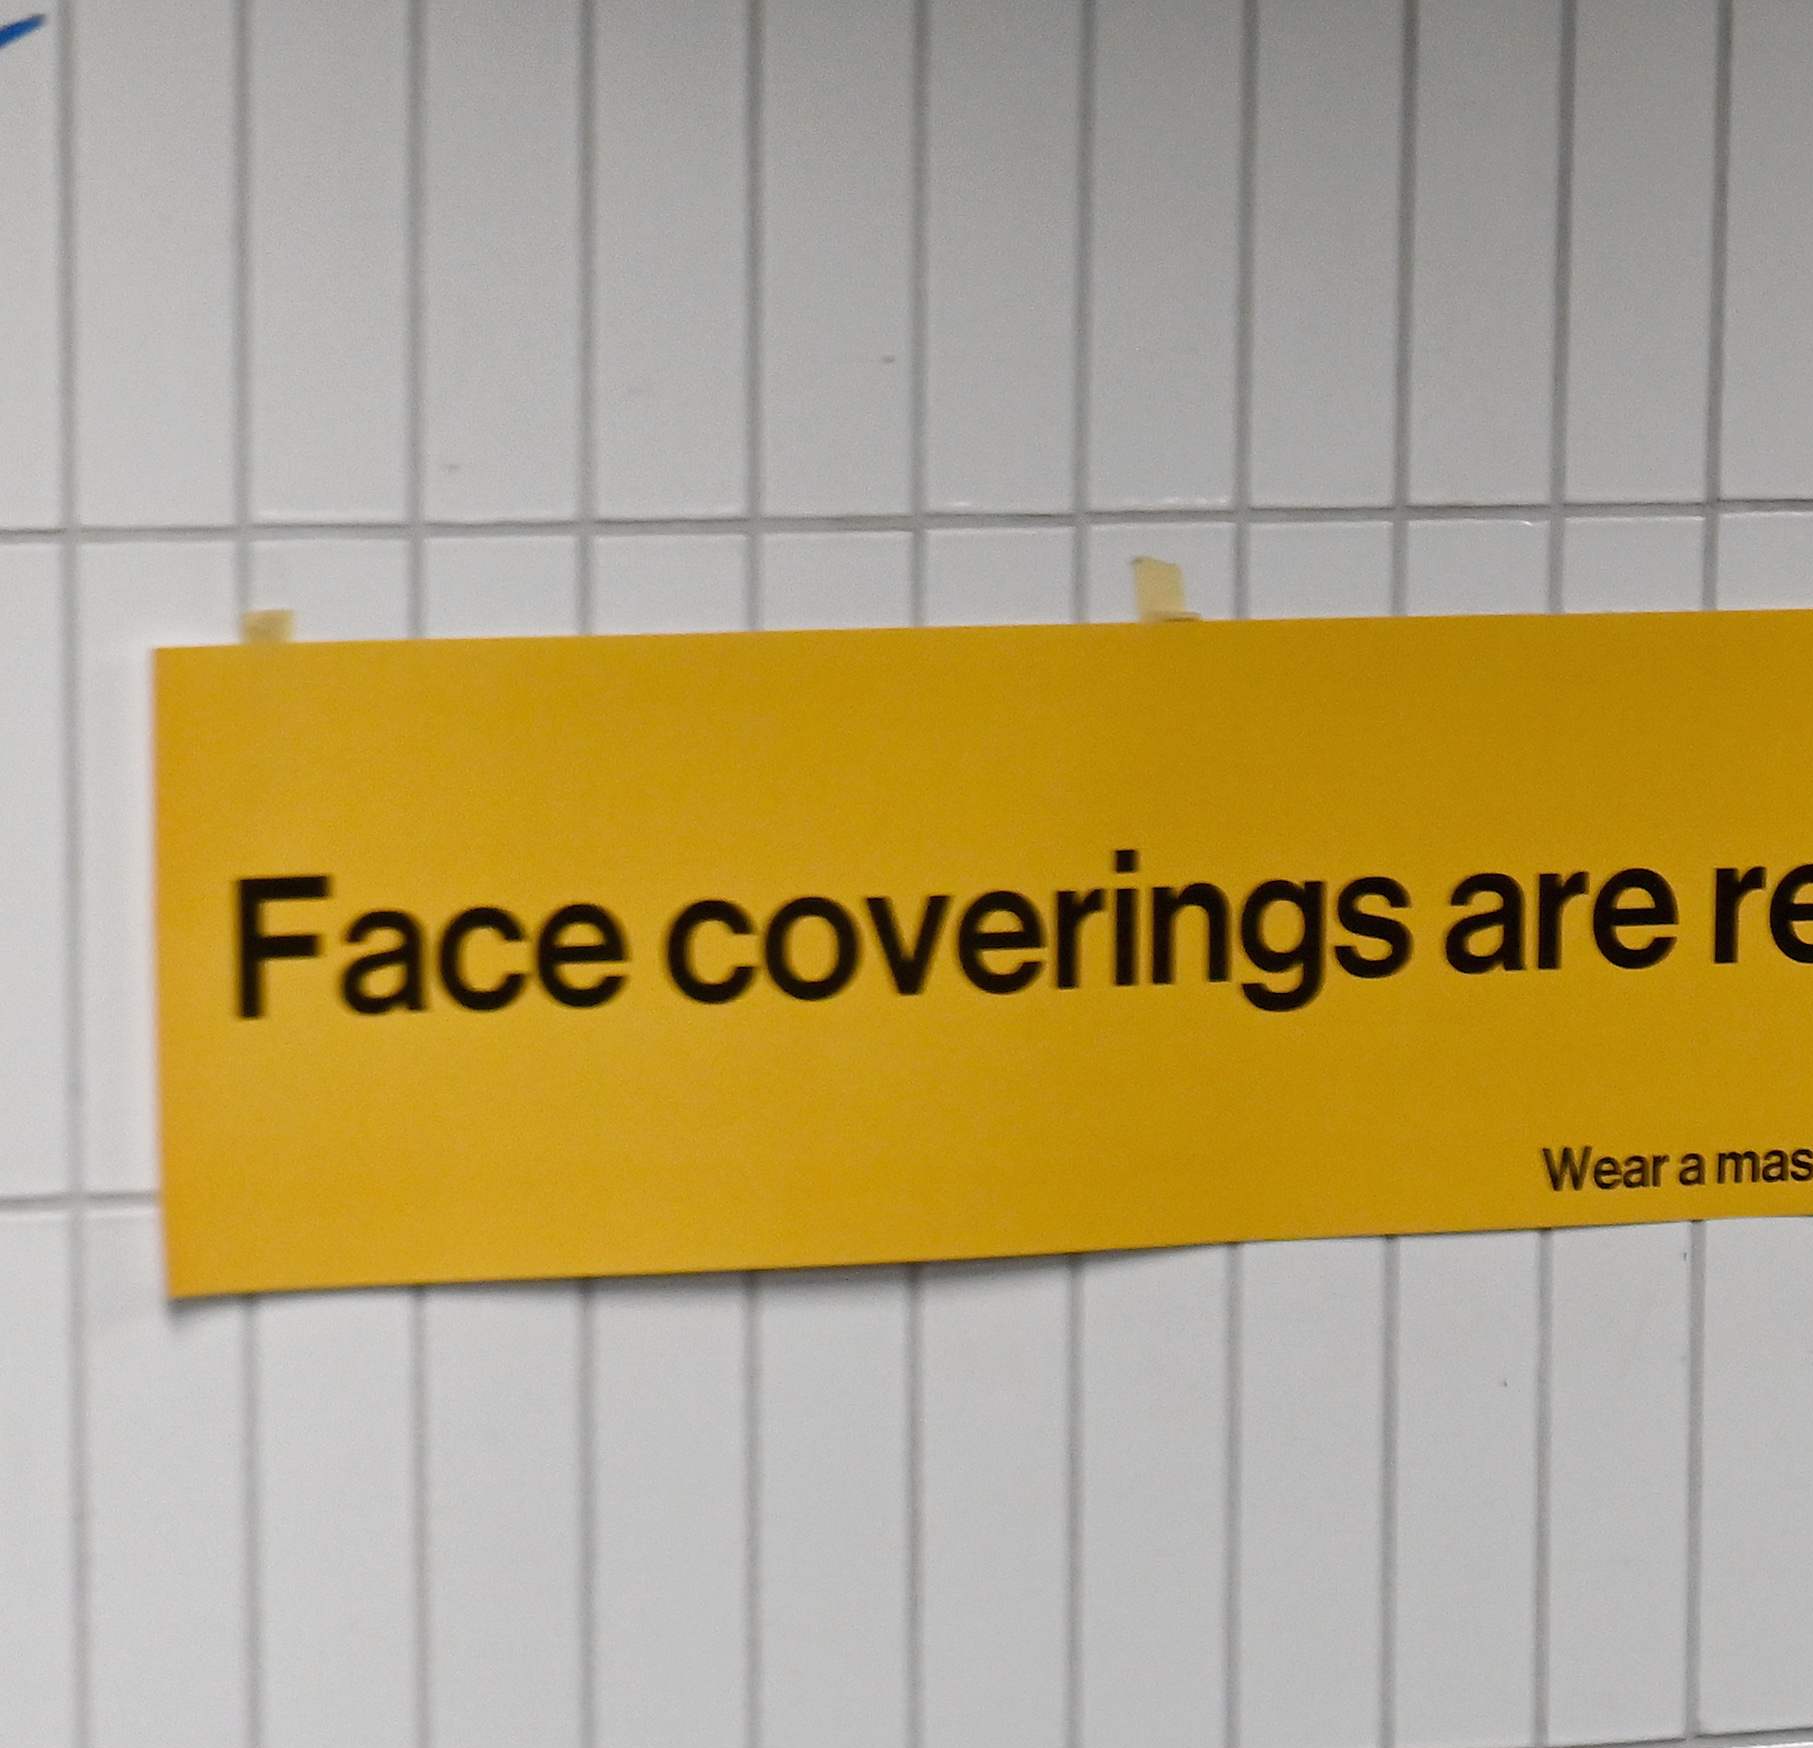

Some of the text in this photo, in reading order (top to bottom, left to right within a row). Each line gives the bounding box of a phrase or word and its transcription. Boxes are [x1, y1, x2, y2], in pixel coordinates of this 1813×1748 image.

[234, 873, 630, 1021] Face
[664, 849, 1414, 1014] coverings
[1443, 866, 1680, 976] are
[1541, 1144, 1671, 1193] Wear
[1678, 1152, 1707, 1187] a
